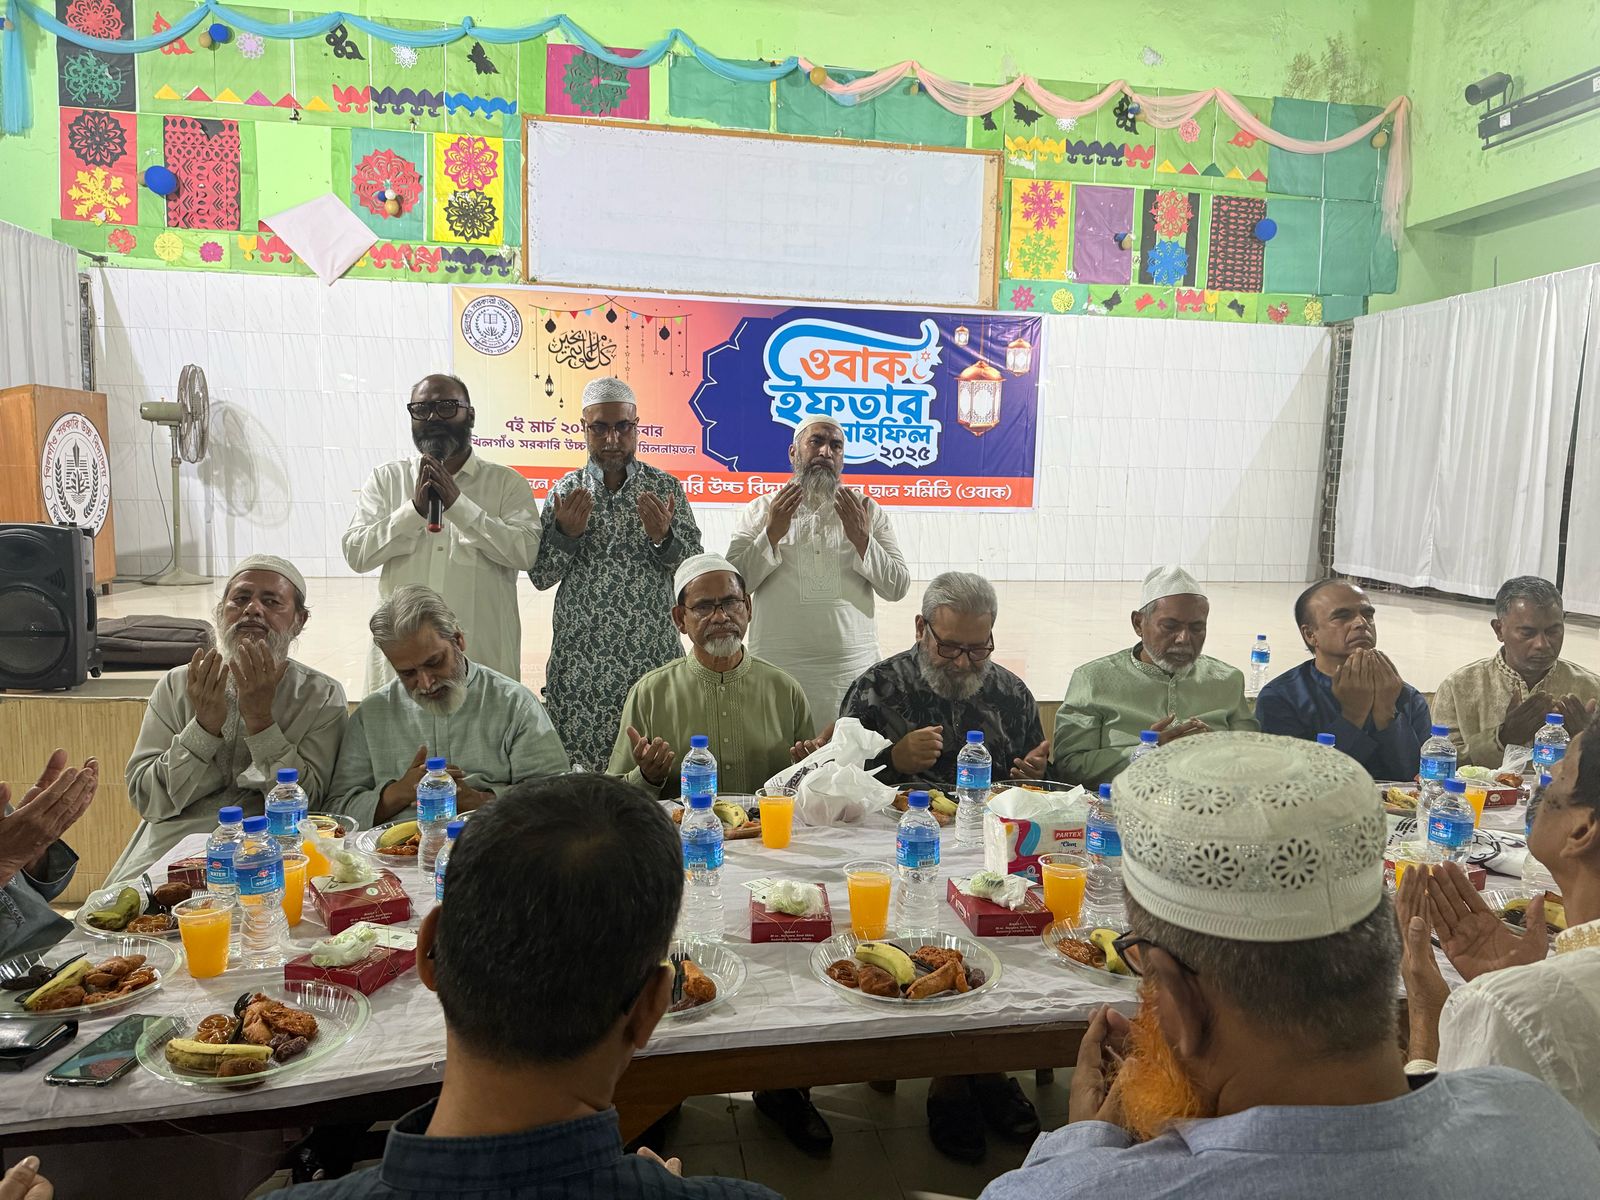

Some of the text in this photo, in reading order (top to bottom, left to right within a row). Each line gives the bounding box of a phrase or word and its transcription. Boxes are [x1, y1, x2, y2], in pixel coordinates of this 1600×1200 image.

[799, 346, 912, 384] ওবাক
[767, 382, 930, 425] ইফতার
[505, 416, 525, 434] ৭ই
[528, 417, 557, 433] মার্চ
[518, 437, 561, 450] সরকারি
[638, 440, 696, 455] মিলনায়তন
[879, 444, 931, 462] ২০২৫
[707, 476, 744, 494] উচ্চ
[868, 483, 900, 498] ছাত্র
[903, 478, 952, 498] সমিতি
[956, 483, 1012, 501] (ওবাক)
[1055, 831, 1082, 839] PARTEX
